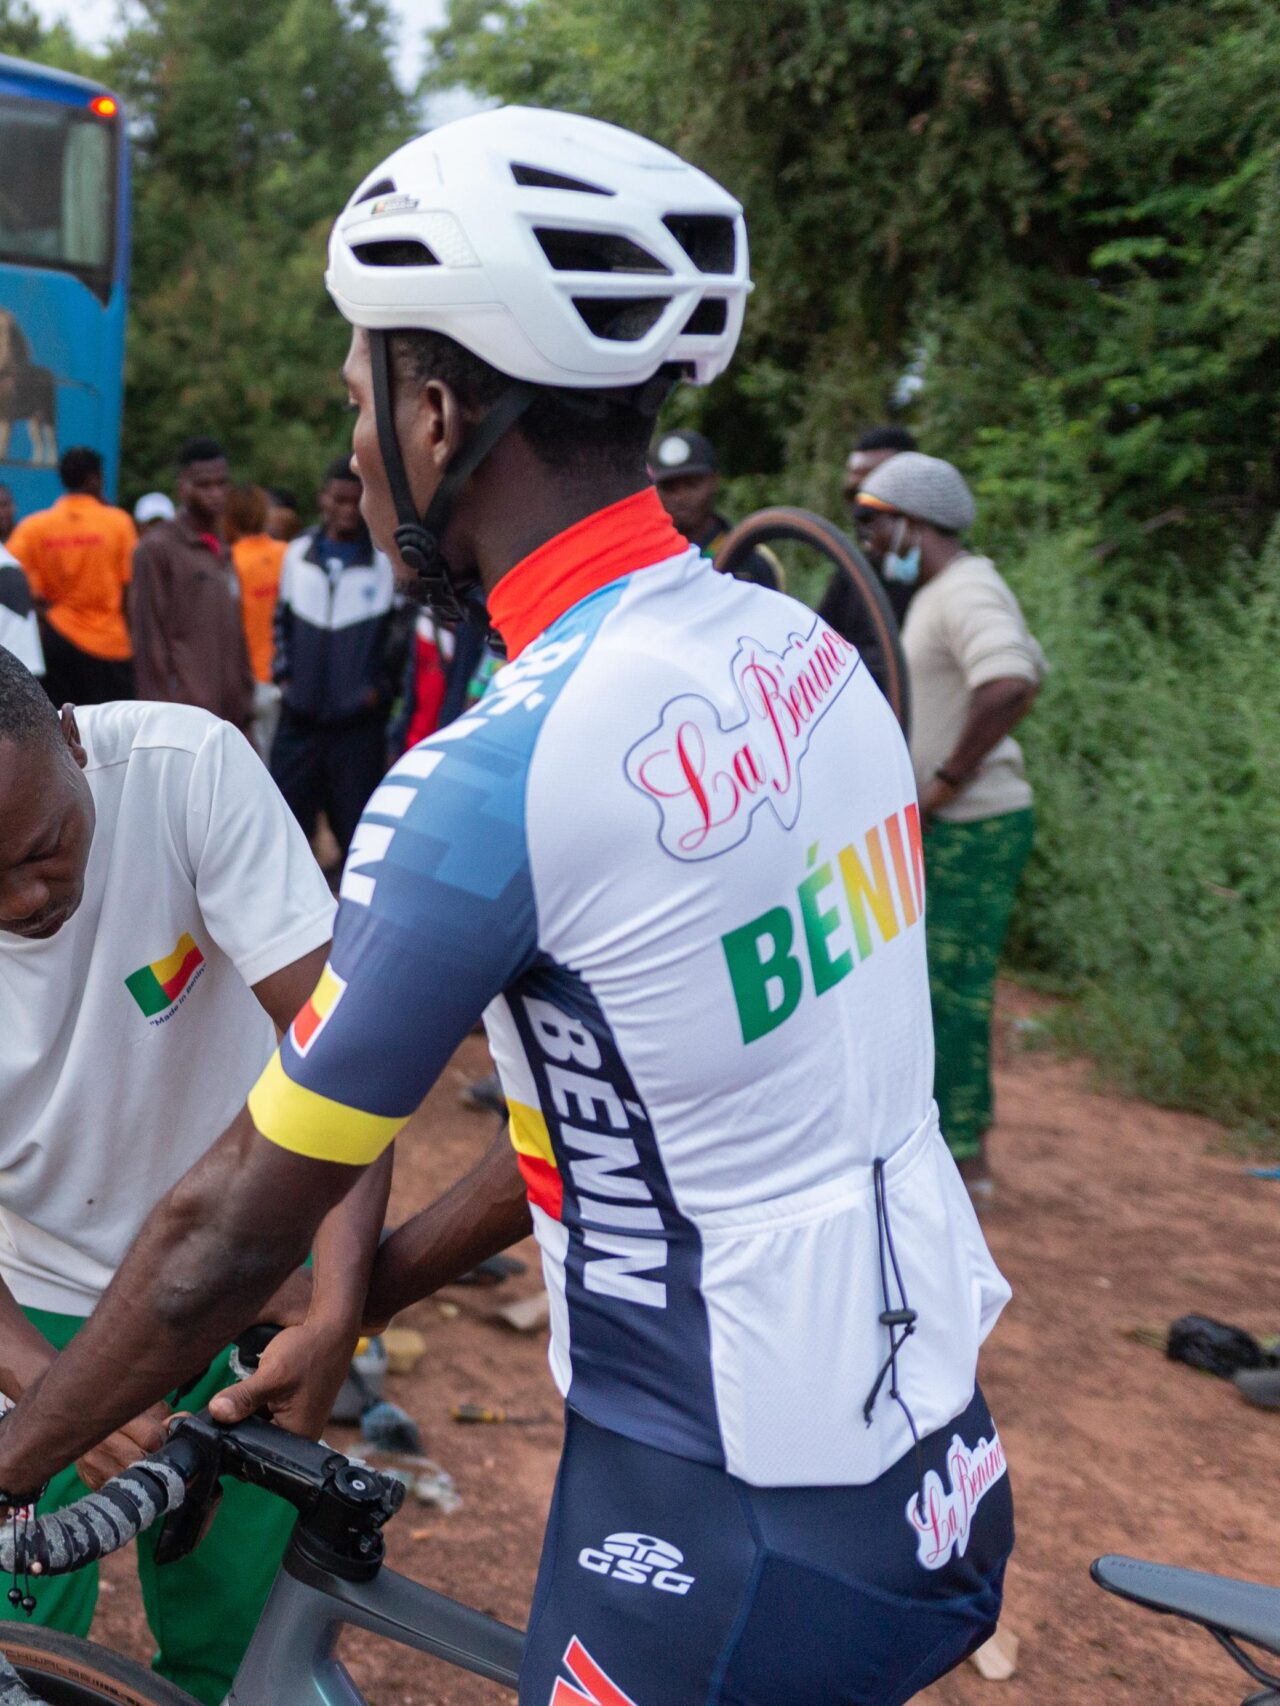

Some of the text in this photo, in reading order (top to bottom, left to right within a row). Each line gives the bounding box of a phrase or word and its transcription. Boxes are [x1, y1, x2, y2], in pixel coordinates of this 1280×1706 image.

[639, 720, 767, 851] La
[522, 995, 668, 1309] BÉNIN
[578, 1547, 696, 1595] GSG
